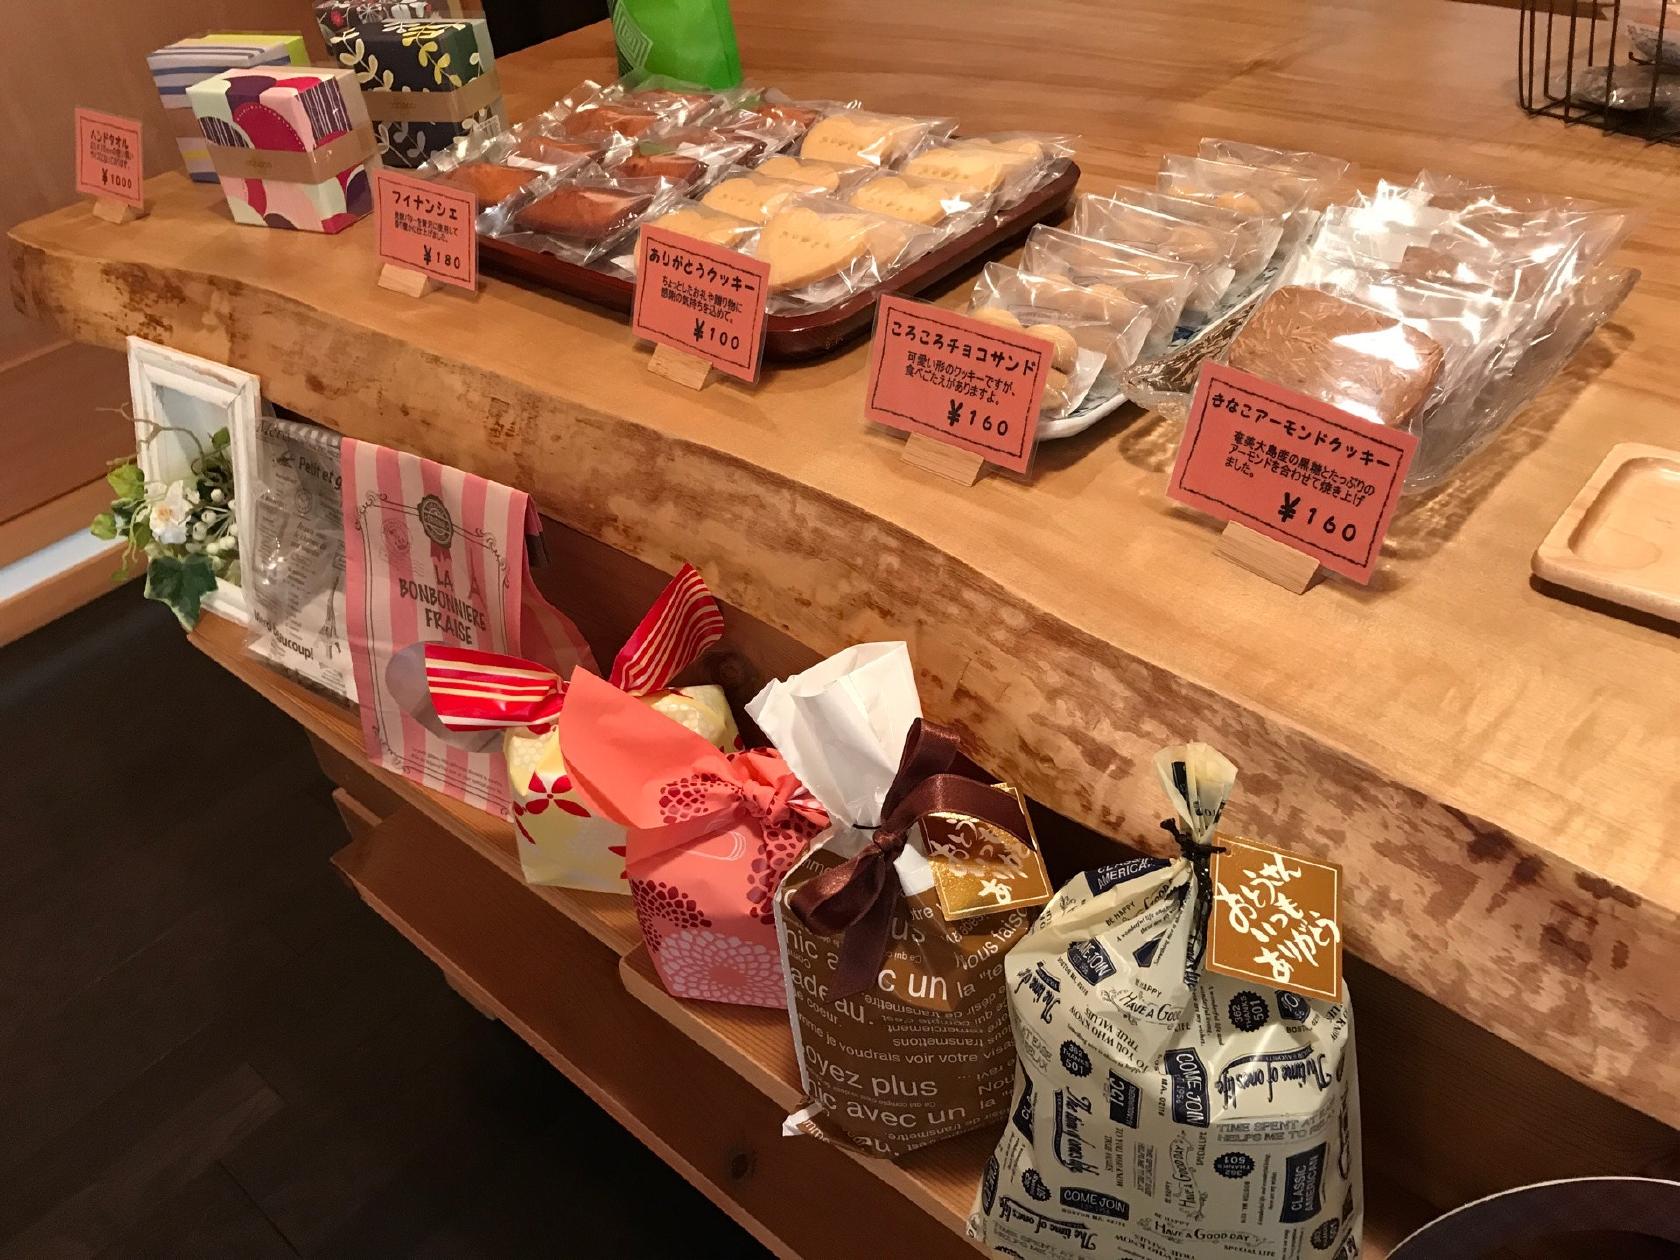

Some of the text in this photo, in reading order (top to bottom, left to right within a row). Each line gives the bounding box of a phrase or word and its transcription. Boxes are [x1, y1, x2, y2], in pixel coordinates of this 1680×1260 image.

[102, 167, 132, 189] ¥1000
[423, 244, 460, 269] ¥180
[649, 247, 755, 292] ありがとうクッキー
[694, 318, 740, 350] ¥100
[891, 321, 1036, 376] ころころチョコサンド
[907, 350, 1016, 396] 可愛い形のクッキーですが、
[947, 399, 1009, 436] ¥160
[1212, 393, 1390, 467] きなこアーモンドクッキー
[1278, 491, 1357, 542] ¥160
[434, 564, 453, 591] LA
[399, 578, 487, 631] BONBONNIERE
[425, 608, 473, 645] FRAISE
[1098, 862, 1157, 891] AMERICA
[1253, 910, 1341, 983] ありがとう
[839, 1041, 901, 1063] voudrais
[905, 1052, 935, 1065] voir
[939, 1052, 978, 1064] votre
[1065, 1058, 1084, 1075] 501
[872, 1075, 938, 1098] plus
[1176, 1053, 1206, 1128] COME JOIN
[846, 1101, 917, 1128] avec
[928, 1106, 966, 1125] un
[1063, 1190, 1126, 1213] COME JOIN
[1291, 1164, 1308, 1211] CLASSIC
